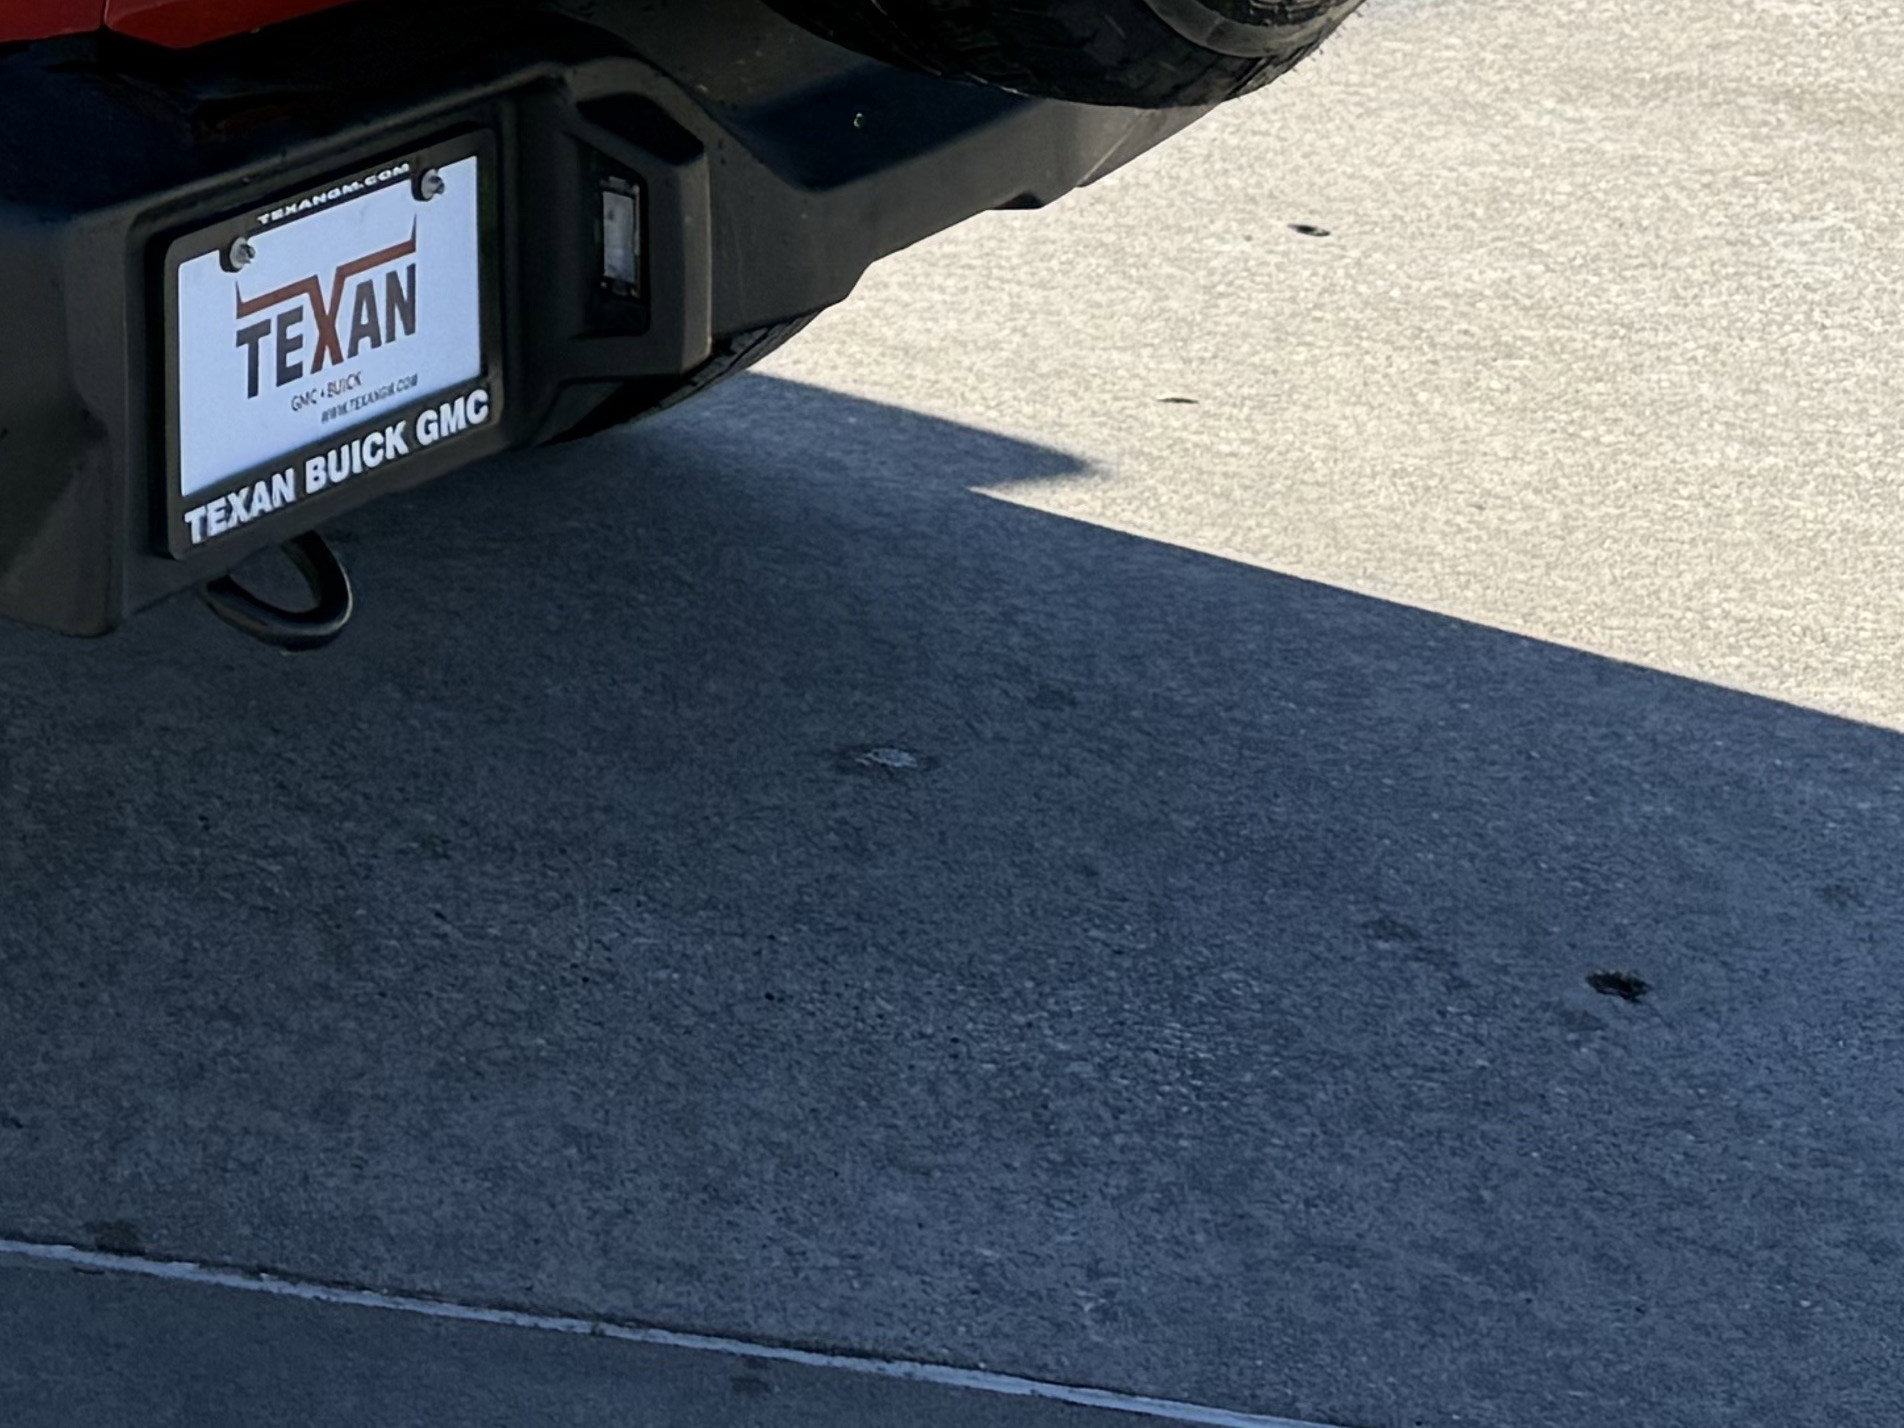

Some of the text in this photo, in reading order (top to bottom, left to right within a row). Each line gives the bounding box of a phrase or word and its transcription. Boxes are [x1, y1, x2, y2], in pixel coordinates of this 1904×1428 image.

[257, 162, 410, 225] TEXANGM.COM
[235, 262, 417, 399] TEXAN
[184, 389, 489, 545] TEXAN BUICK GMC
